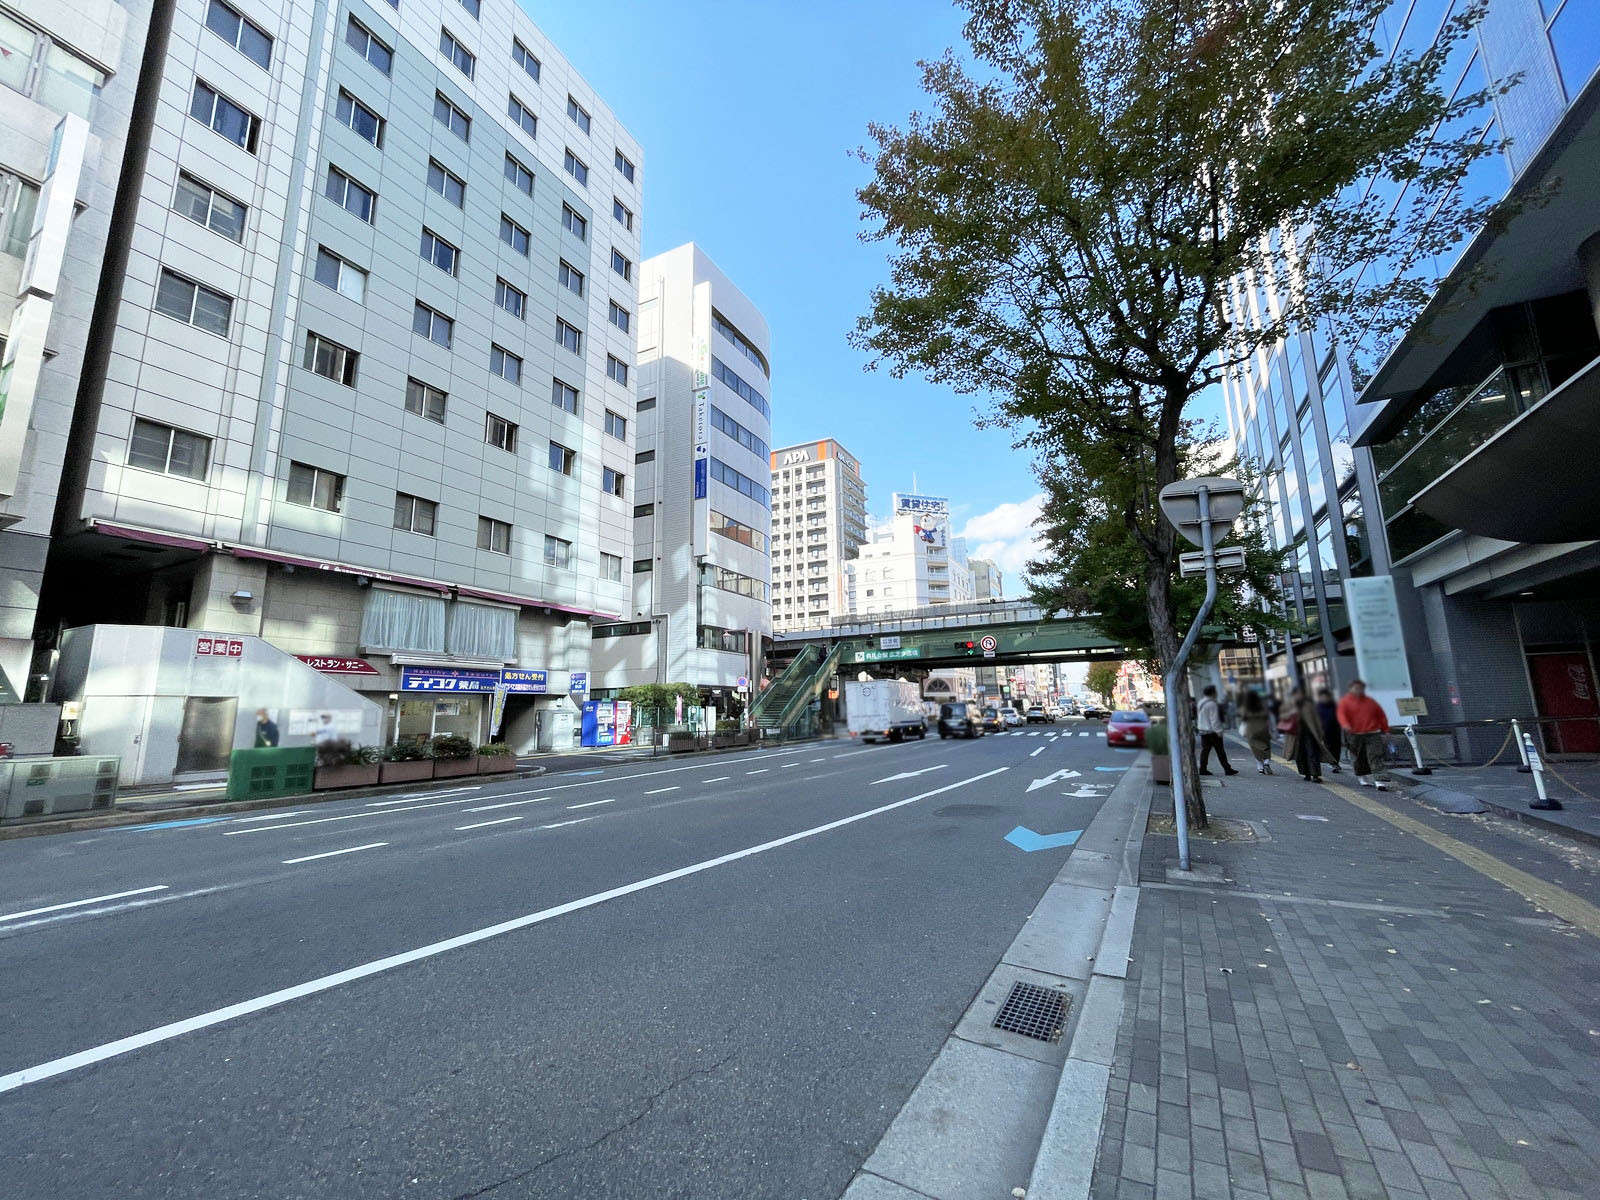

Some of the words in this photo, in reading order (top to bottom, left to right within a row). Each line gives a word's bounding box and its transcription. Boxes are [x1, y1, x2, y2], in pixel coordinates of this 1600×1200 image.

[783, 449, 810, 465] APA
[198, 641, 242, 655] 営業中
[307, 658, 364, 669] レストラン・サニー
